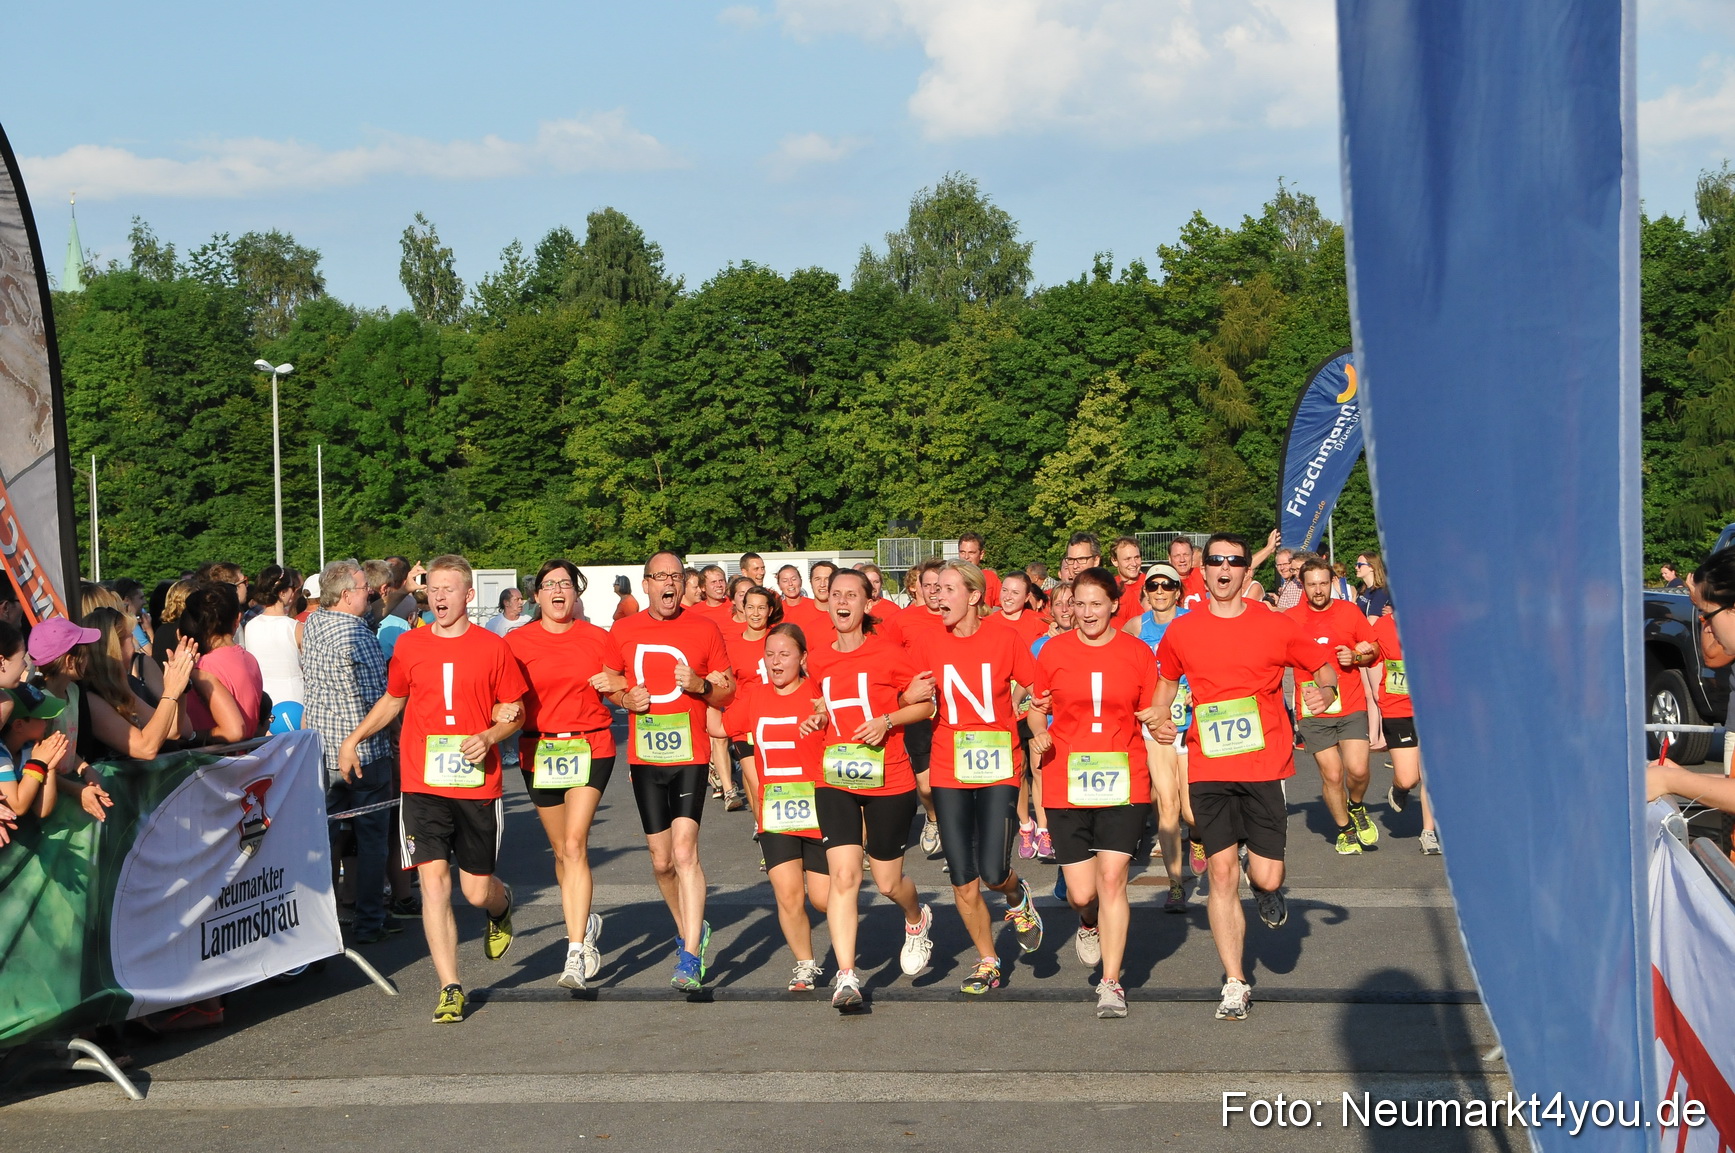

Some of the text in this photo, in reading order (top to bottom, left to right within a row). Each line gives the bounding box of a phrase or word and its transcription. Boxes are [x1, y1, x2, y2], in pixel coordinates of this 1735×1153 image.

[1286, 404, 1356, 517] Frischmann
[634, 643, 688, 704] D
[1392, 672, 1406, 686] 17
[822, 672, 874, 737] H
[943, 663, 996, 725] N
[1173, 704, 1183, 720] 3
[1208, 717, 1252, 743] 179
[643, 731, 682, 751] 189
[756, 716, 802, 775] E
[434, 752, 475, 774] 159
[543, 755, 579, 775] 161
[832, 760, 873, 780] 162
[963, 749, 1000, 770] 181
[1077, 771, 1119, 792] 167
[771, 800, 811, 820] 168
[200, 894, 300, 961] Lammsbräu
